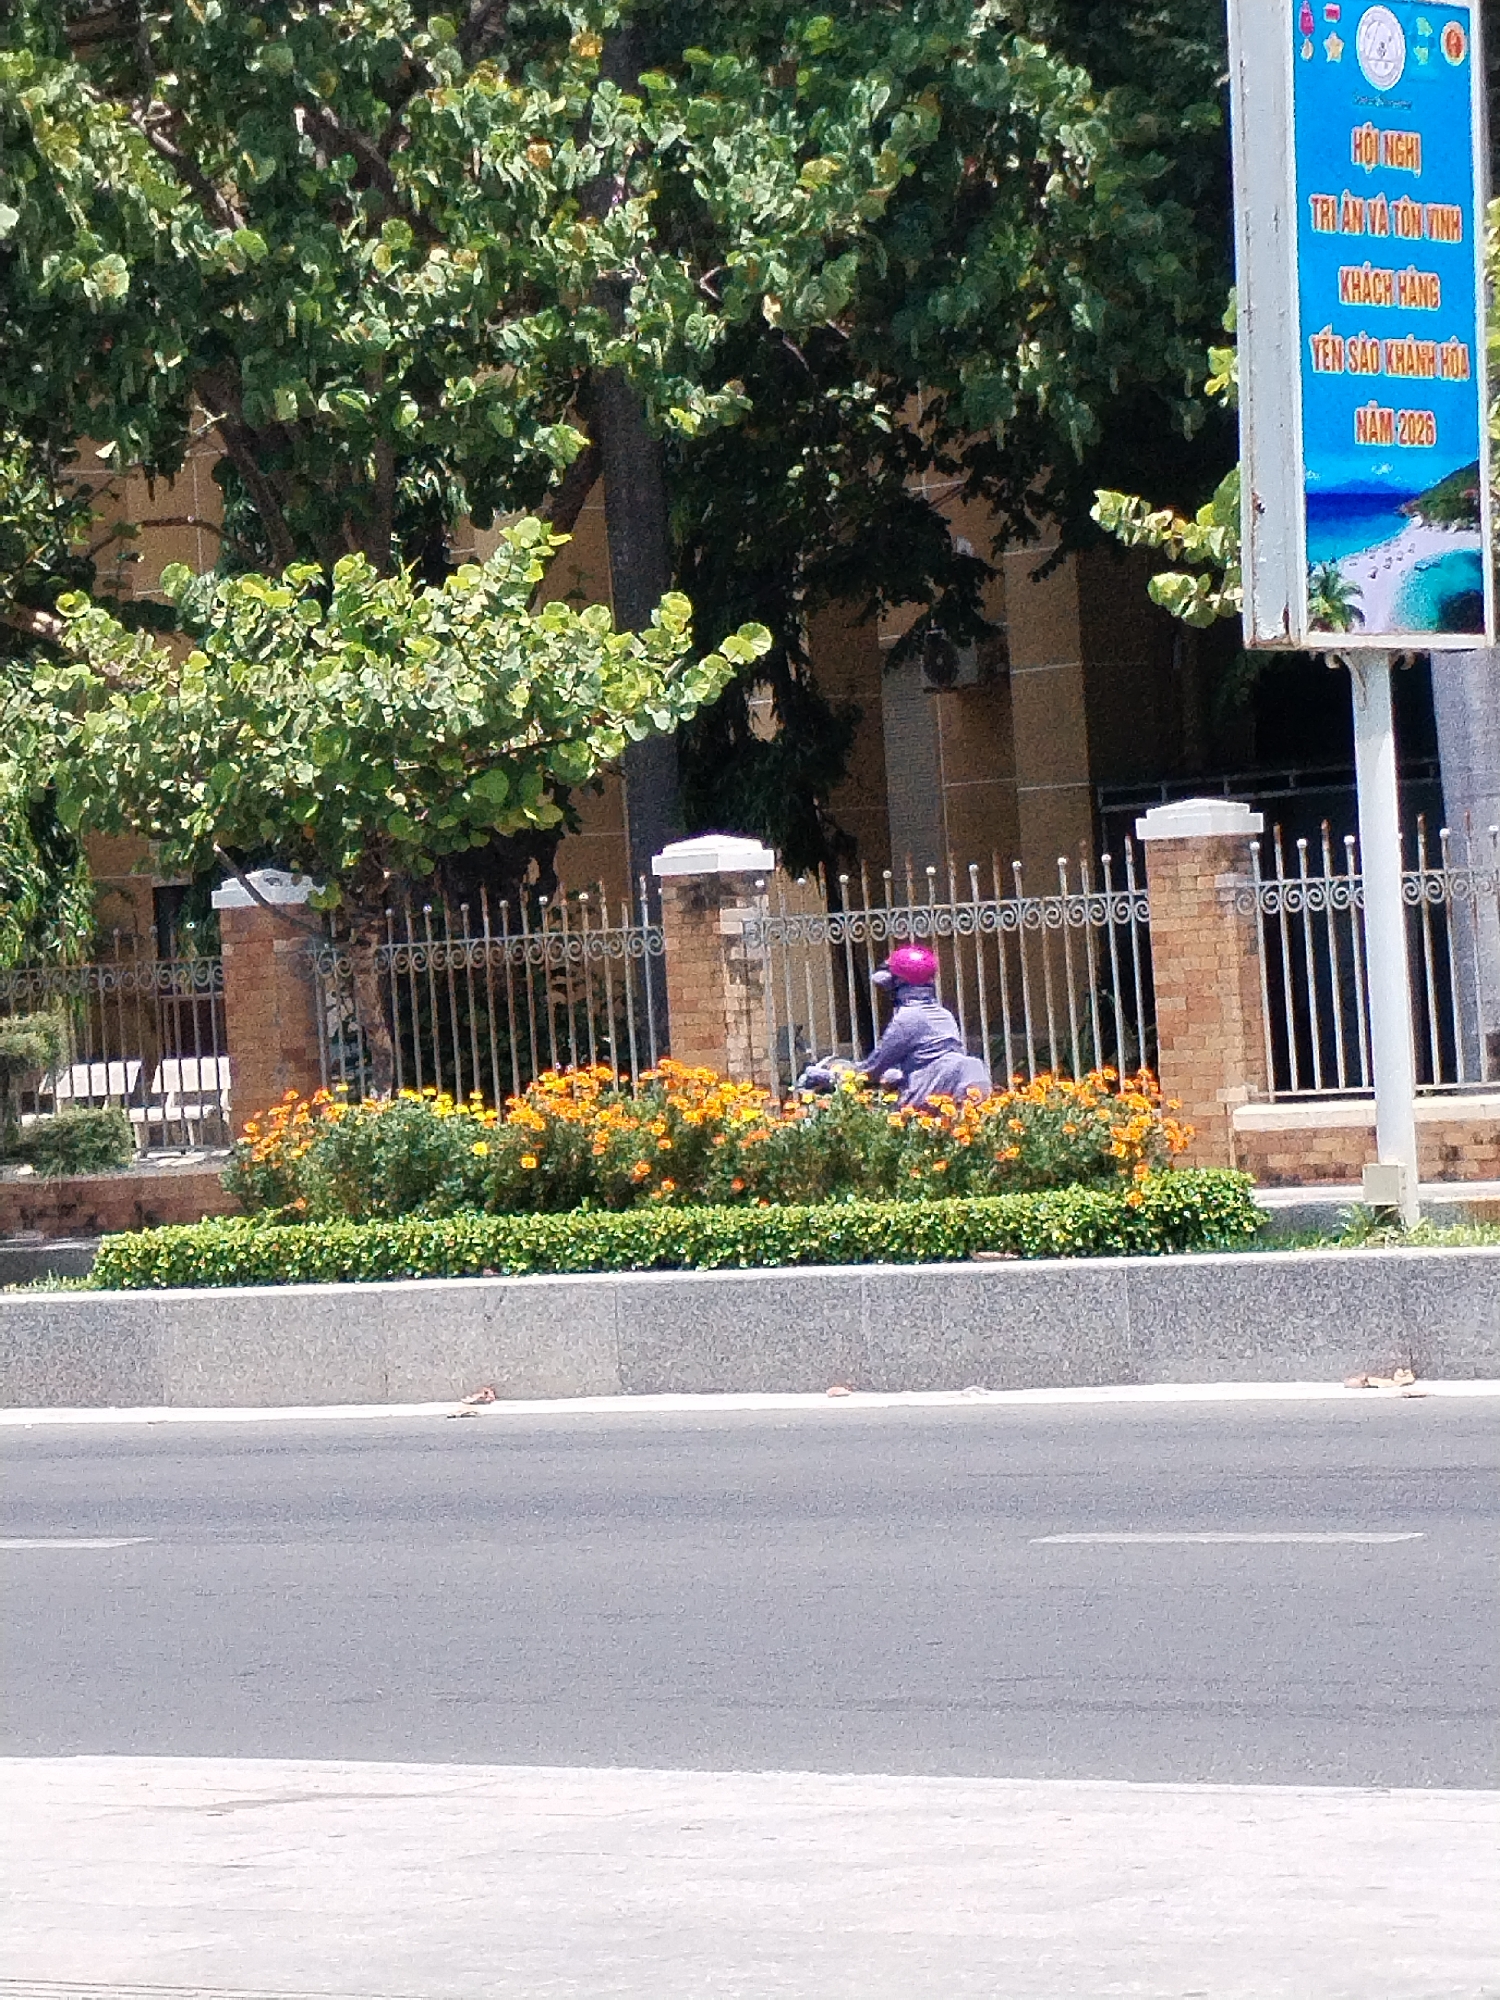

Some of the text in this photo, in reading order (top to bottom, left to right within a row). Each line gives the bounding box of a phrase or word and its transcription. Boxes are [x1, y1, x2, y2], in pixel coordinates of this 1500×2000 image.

[1310, 195, 1336, 233] TRI
[1392, 195, 1422, 239] TÔN
[1426, 204, 1461, 242] VINH
[1309, 324, 1343, 373] YẾN
